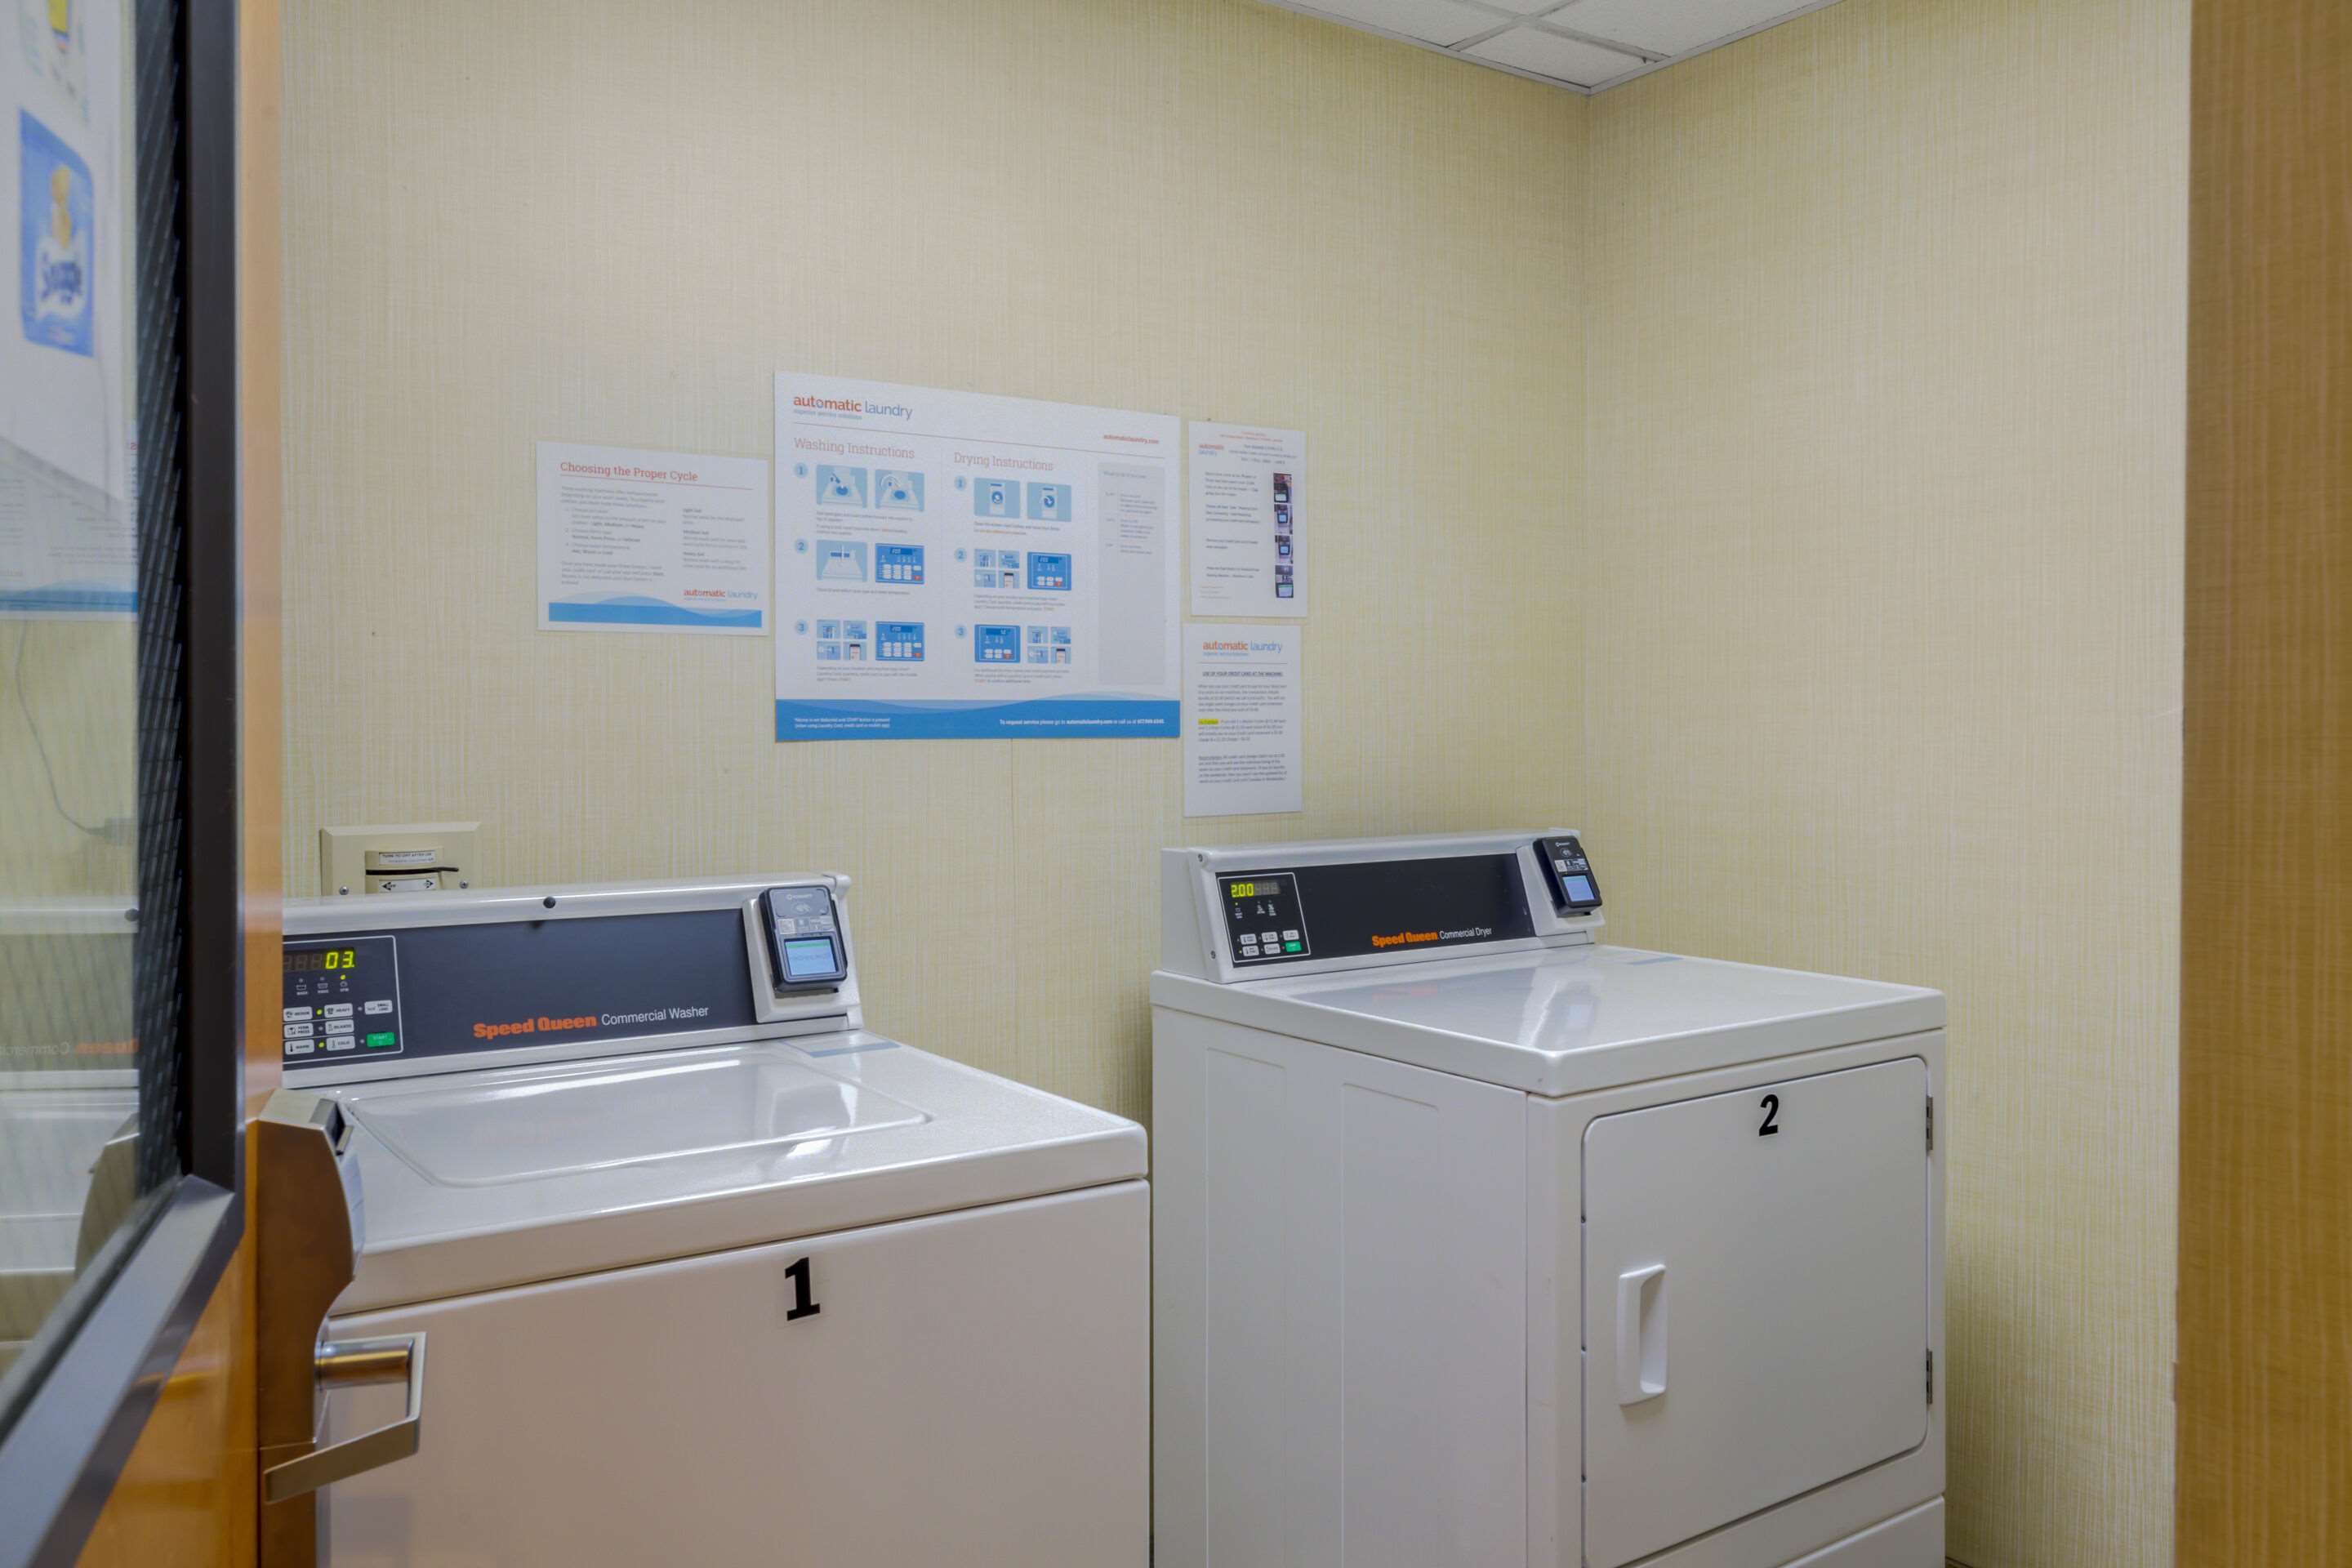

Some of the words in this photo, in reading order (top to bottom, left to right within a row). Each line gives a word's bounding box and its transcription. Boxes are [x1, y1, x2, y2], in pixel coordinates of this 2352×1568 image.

[794, 395, 862, 412] automatic
[865, 400, 913, 421] laundry
[794, 437, 844, 454] Washing
[848, 443, 915, 459] Instructions
[560, 461, 611, 476] Choosing
[613, 466, 630, 476] the
[634, 468, 667, 480] Proper
[670, 470, 698, 482] Cycle
[954, 452, 990, 469] Drying
[992, 456, 1054, 471] Instructions
[684, 588, 726, 599] automatic
[727, 589, 758, 600] laundry
[1203, 640, 1248, 651] automatic
[1250, 639, 1282, 653] laundry
[1372, 933, 1405, 947] Speed
[1405, 931, 1438, 942] Queen
[1439, 928, 1475, 940] Commercial
[1476, 927, 1492, 938] Dryer
[473, 1018, 535, 1040] Speed
[537, 1015, 597, 1031] Queen
[601, 1009, 666, 1026] Commercial
[669, 1005, 709, 1020] Washer
[1759, 1094, 1779, 1137] 2
[785, 1257, 821, 1321] 1
